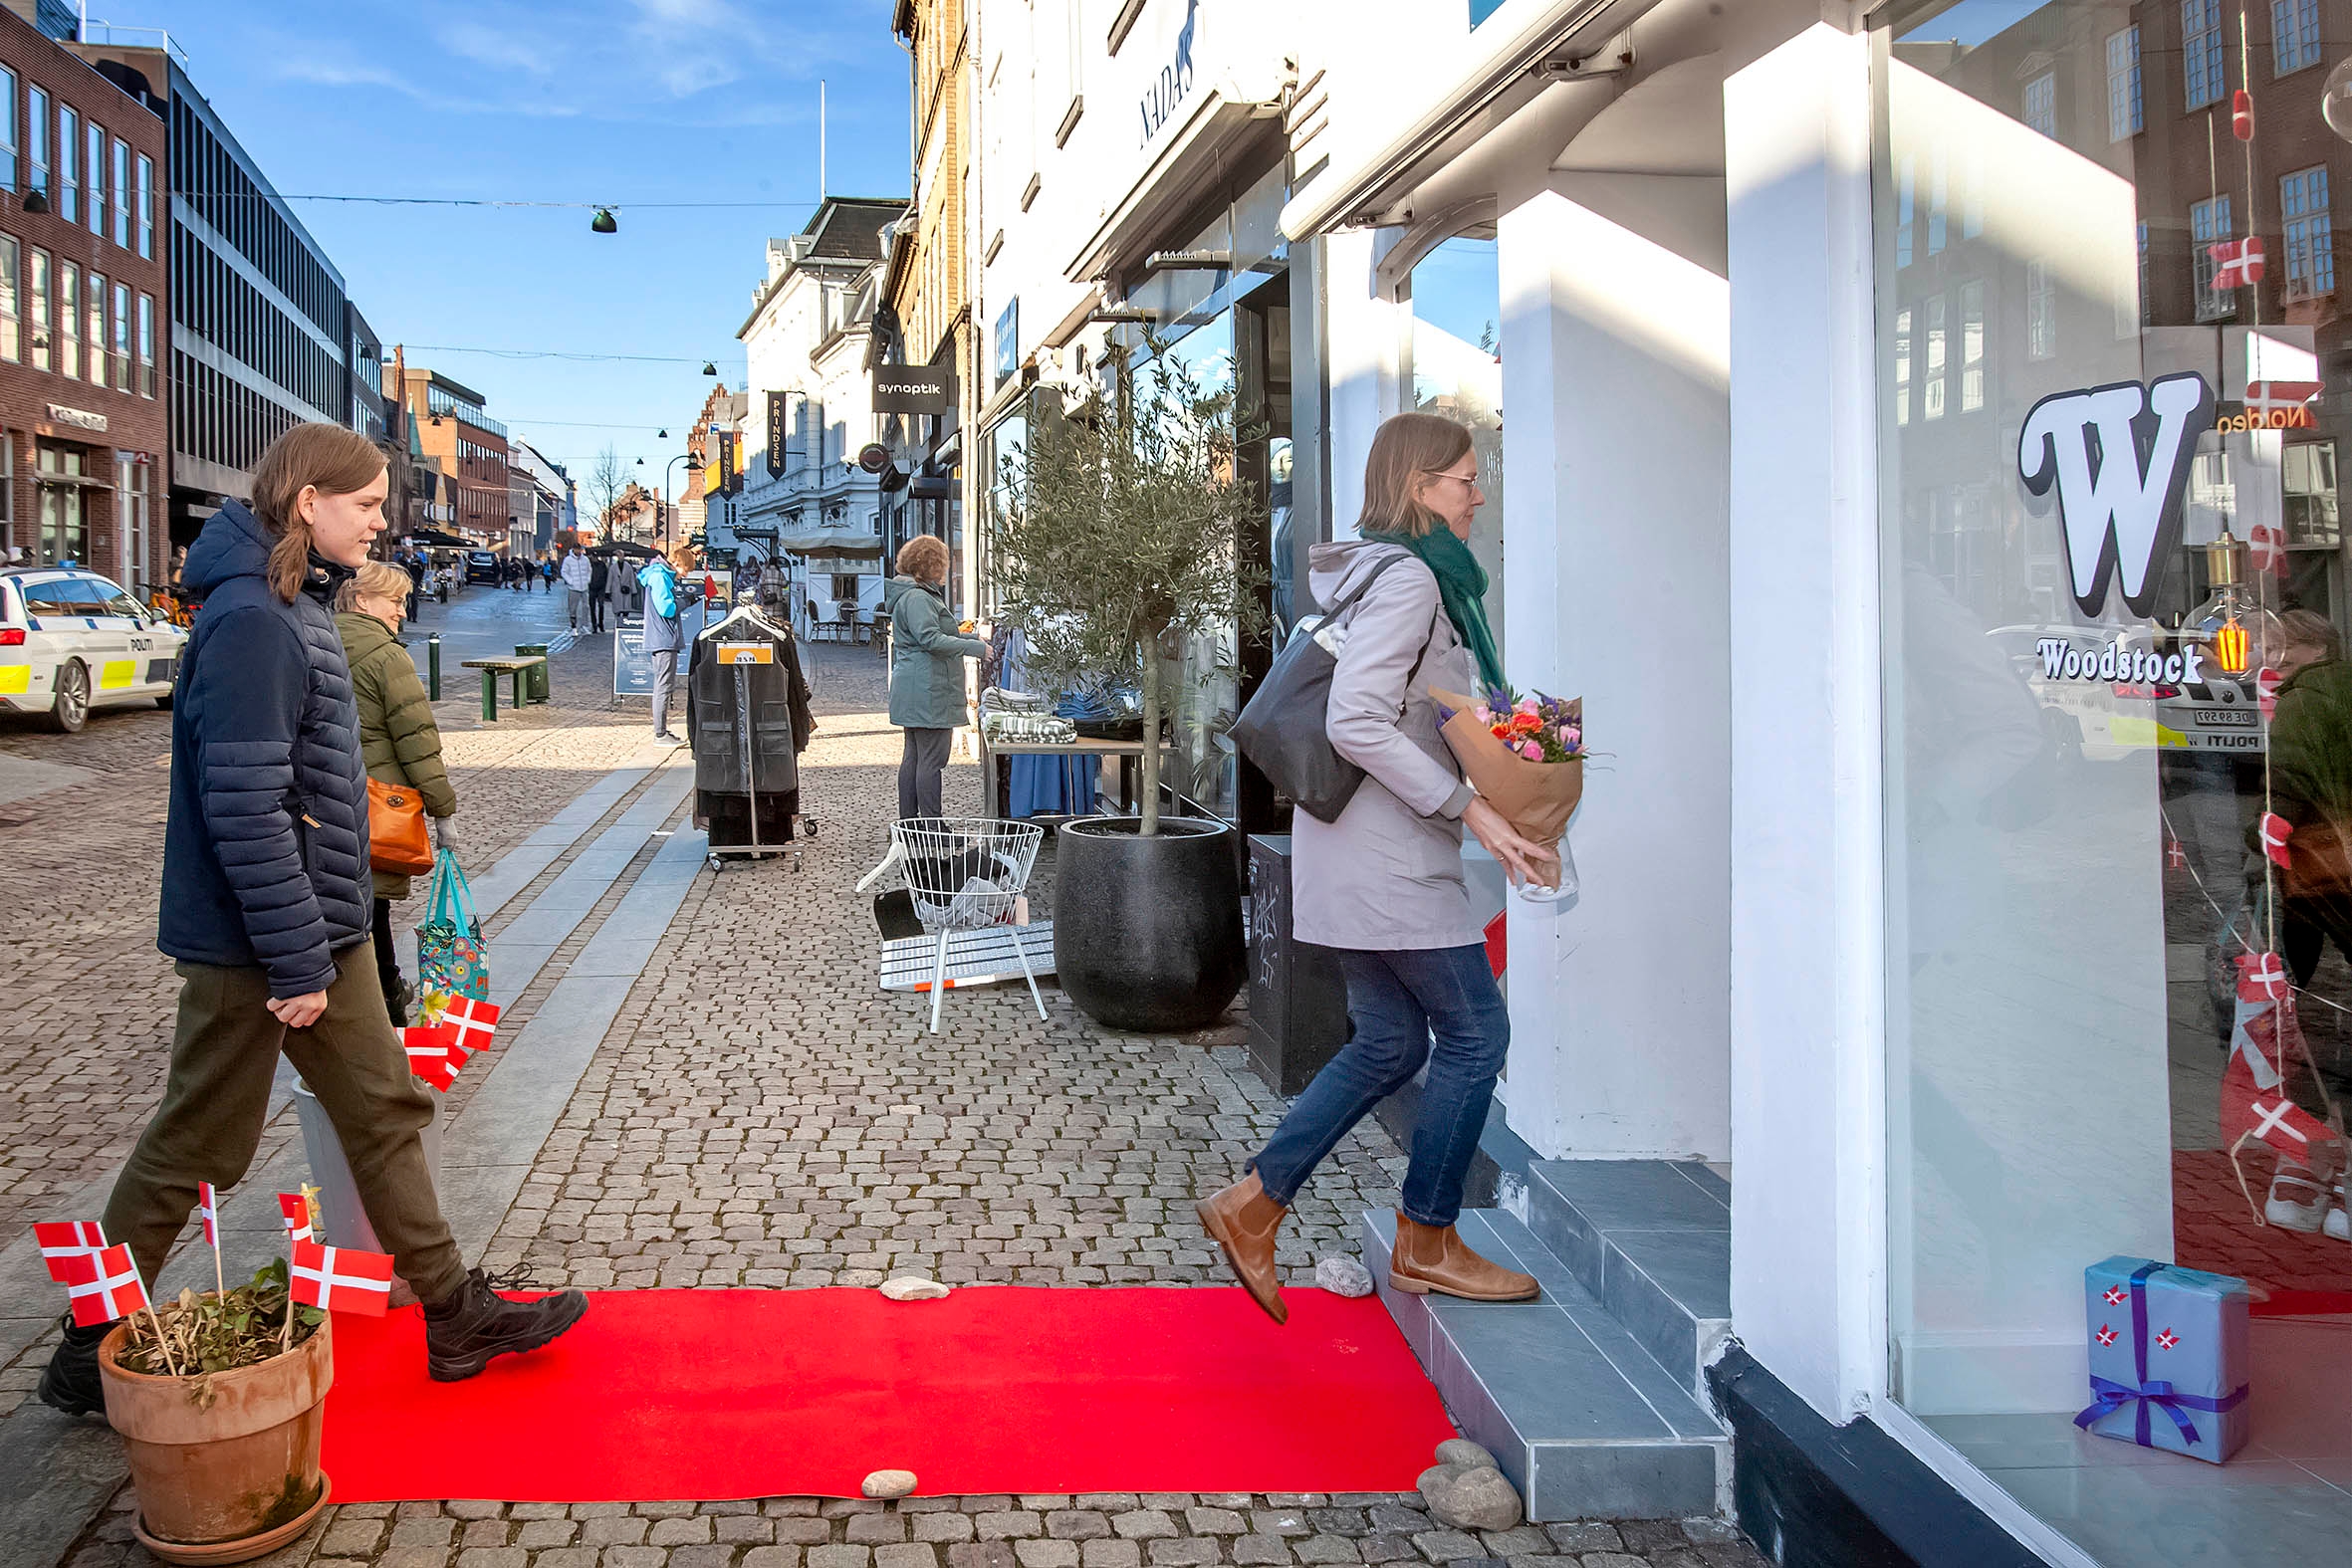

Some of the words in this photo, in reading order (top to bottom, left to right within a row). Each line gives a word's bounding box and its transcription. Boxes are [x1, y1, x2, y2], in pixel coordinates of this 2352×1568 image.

[877, 383, 941, 396] synoptik
[773, 400, 782, 469] PRINDSEN
[2018, 370, 2215, 618] W
[130, 638, 154, 652] POLITI
[2036, 638, 2203, 686] Woodstock
